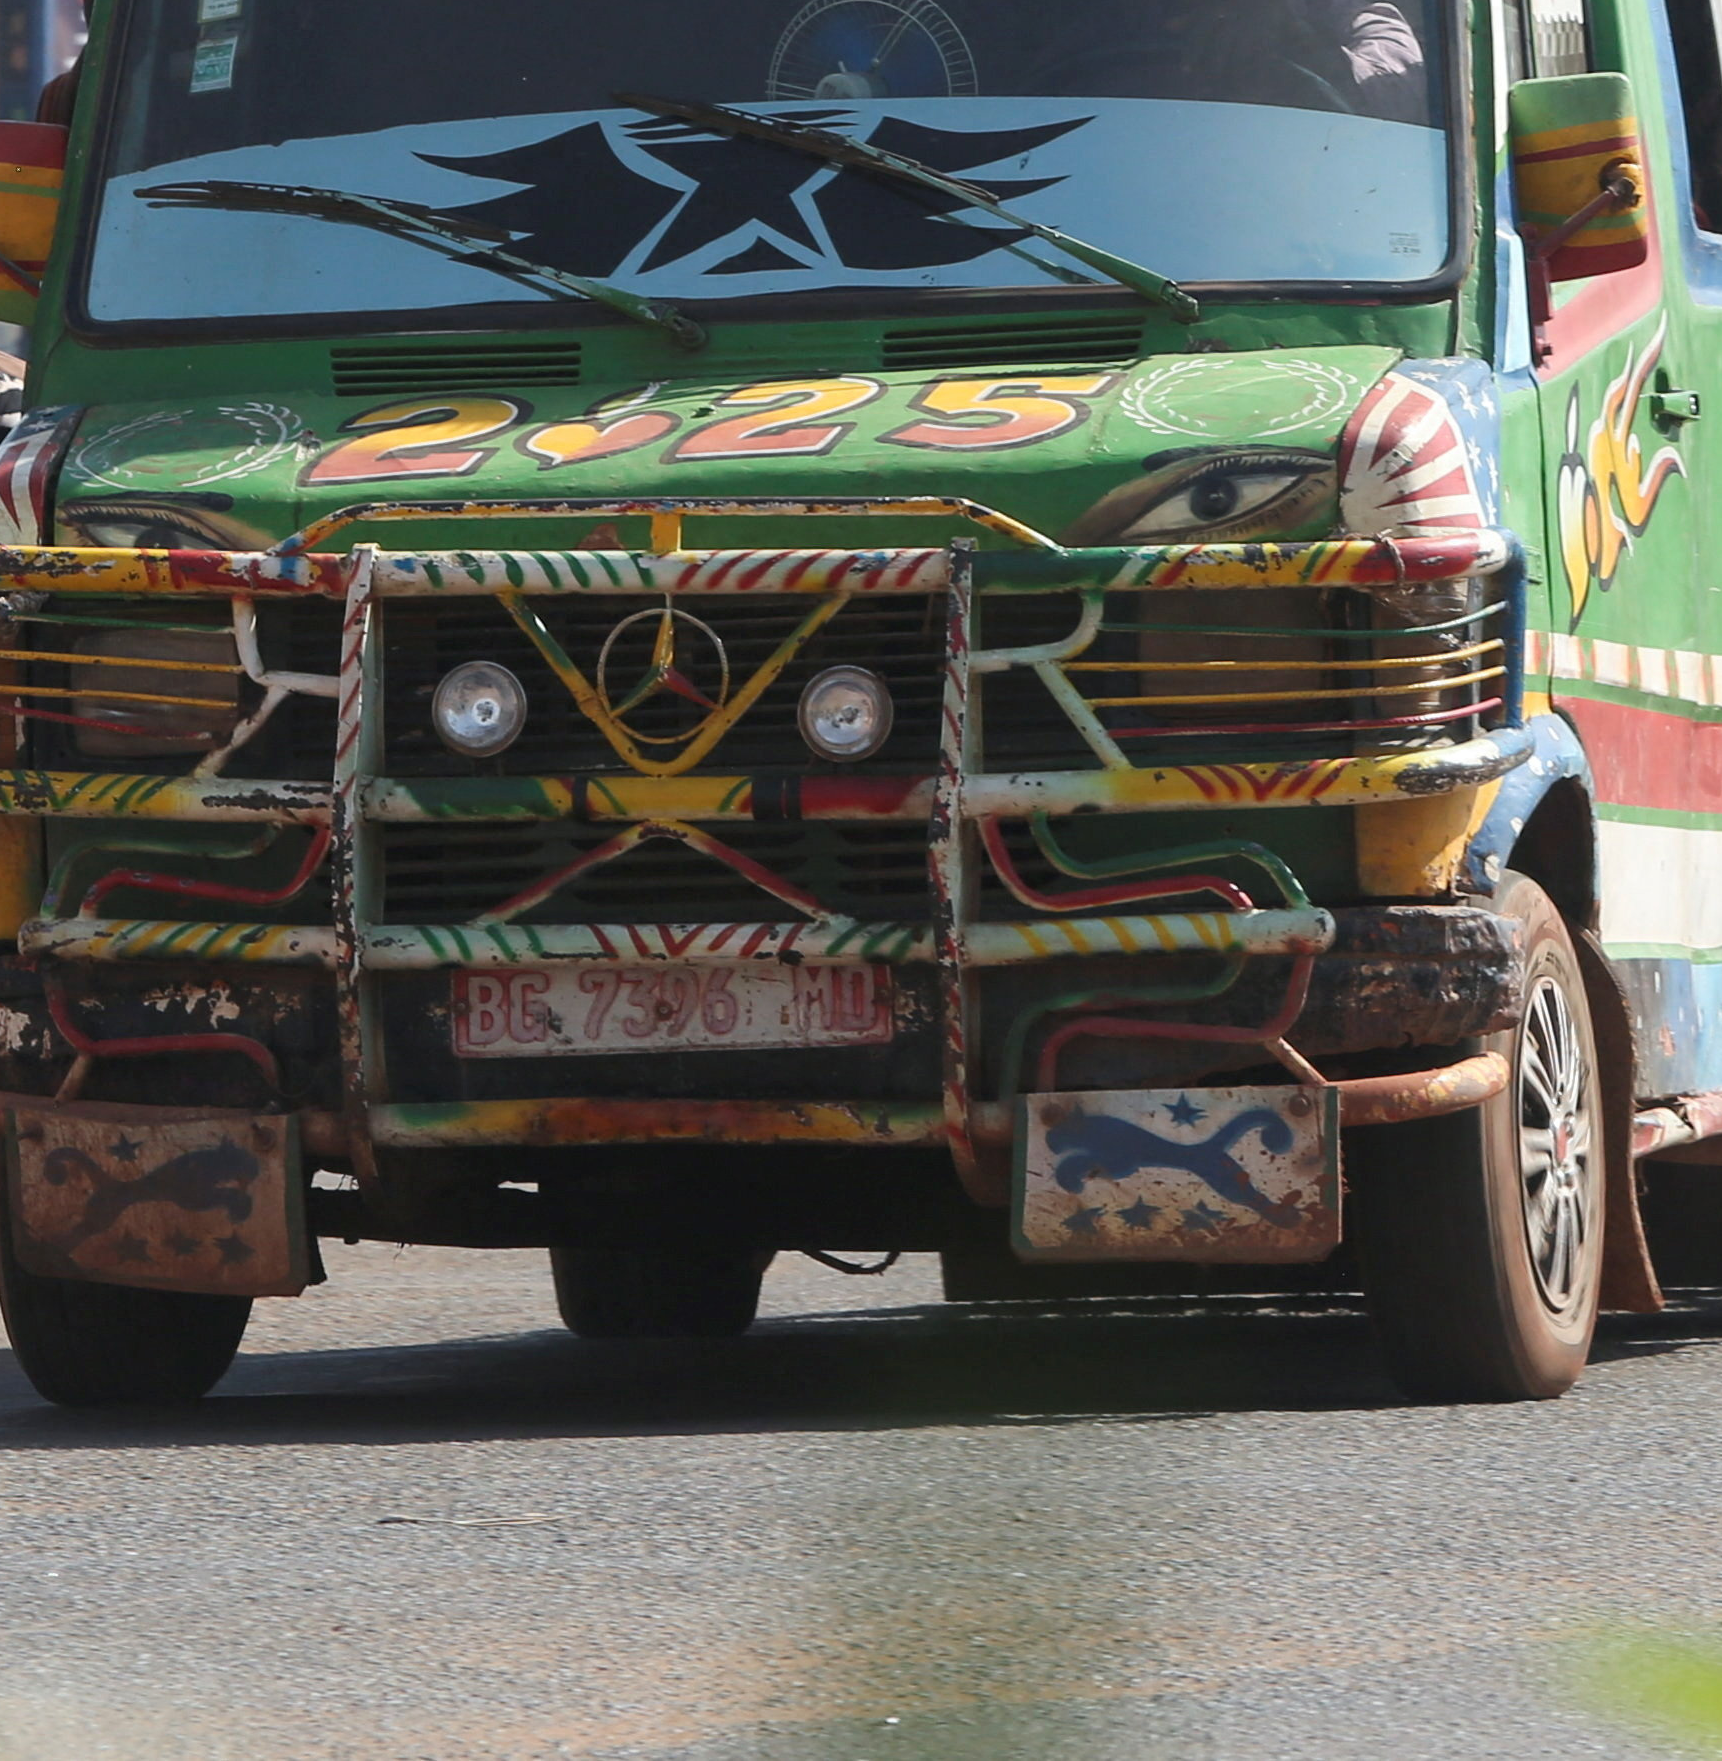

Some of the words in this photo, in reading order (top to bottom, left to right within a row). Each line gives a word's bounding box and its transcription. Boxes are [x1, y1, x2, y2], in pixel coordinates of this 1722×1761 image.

[466, 972, 551, 1045] BG
[580, 966, 740, 1039] 7396
[794, 965, 876, 1032] MD
